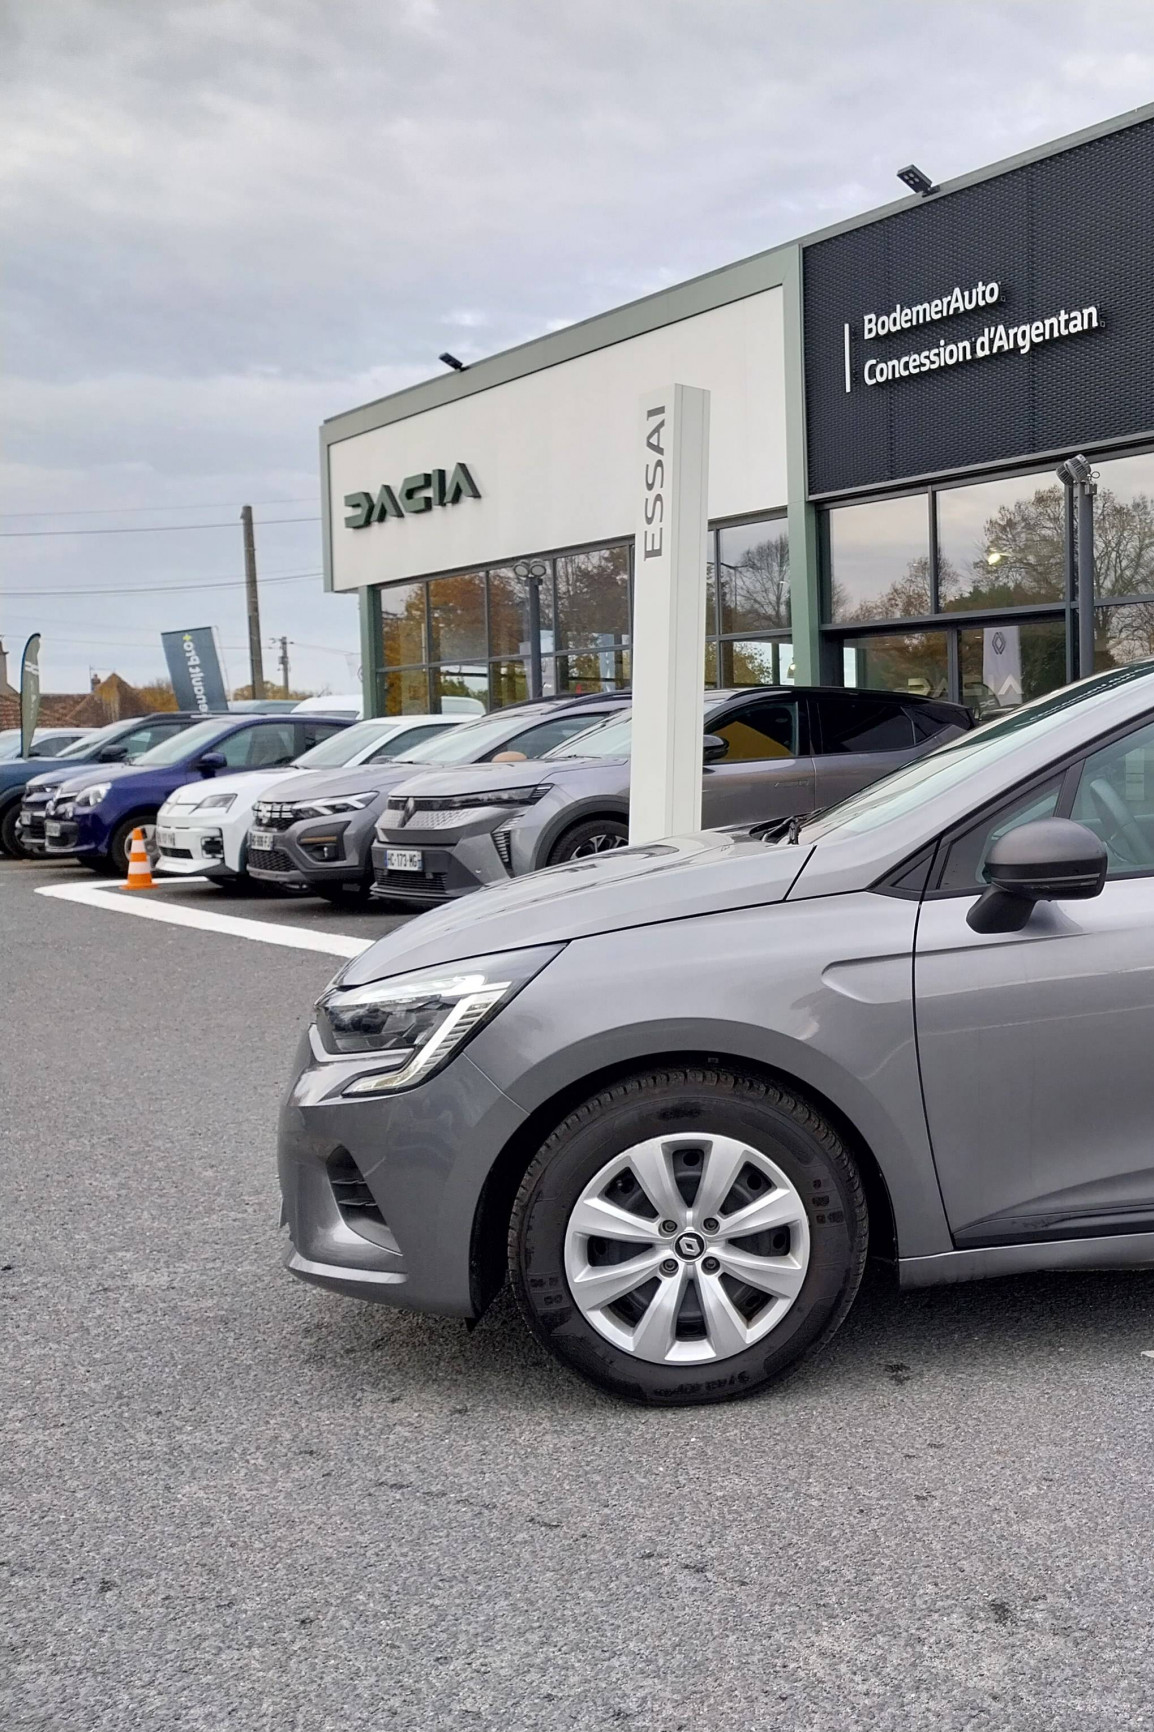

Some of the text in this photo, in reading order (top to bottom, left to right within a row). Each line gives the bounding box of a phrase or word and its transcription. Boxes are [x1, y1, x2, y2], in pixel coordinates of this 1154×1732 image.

[863, 281, 999, 340] BodemerAuto
[863, 305, 1099, 386] Concession d'Argentan
[344, 462, 482, 529] DACIA
[643, 405, 666, 562] ESSAI
